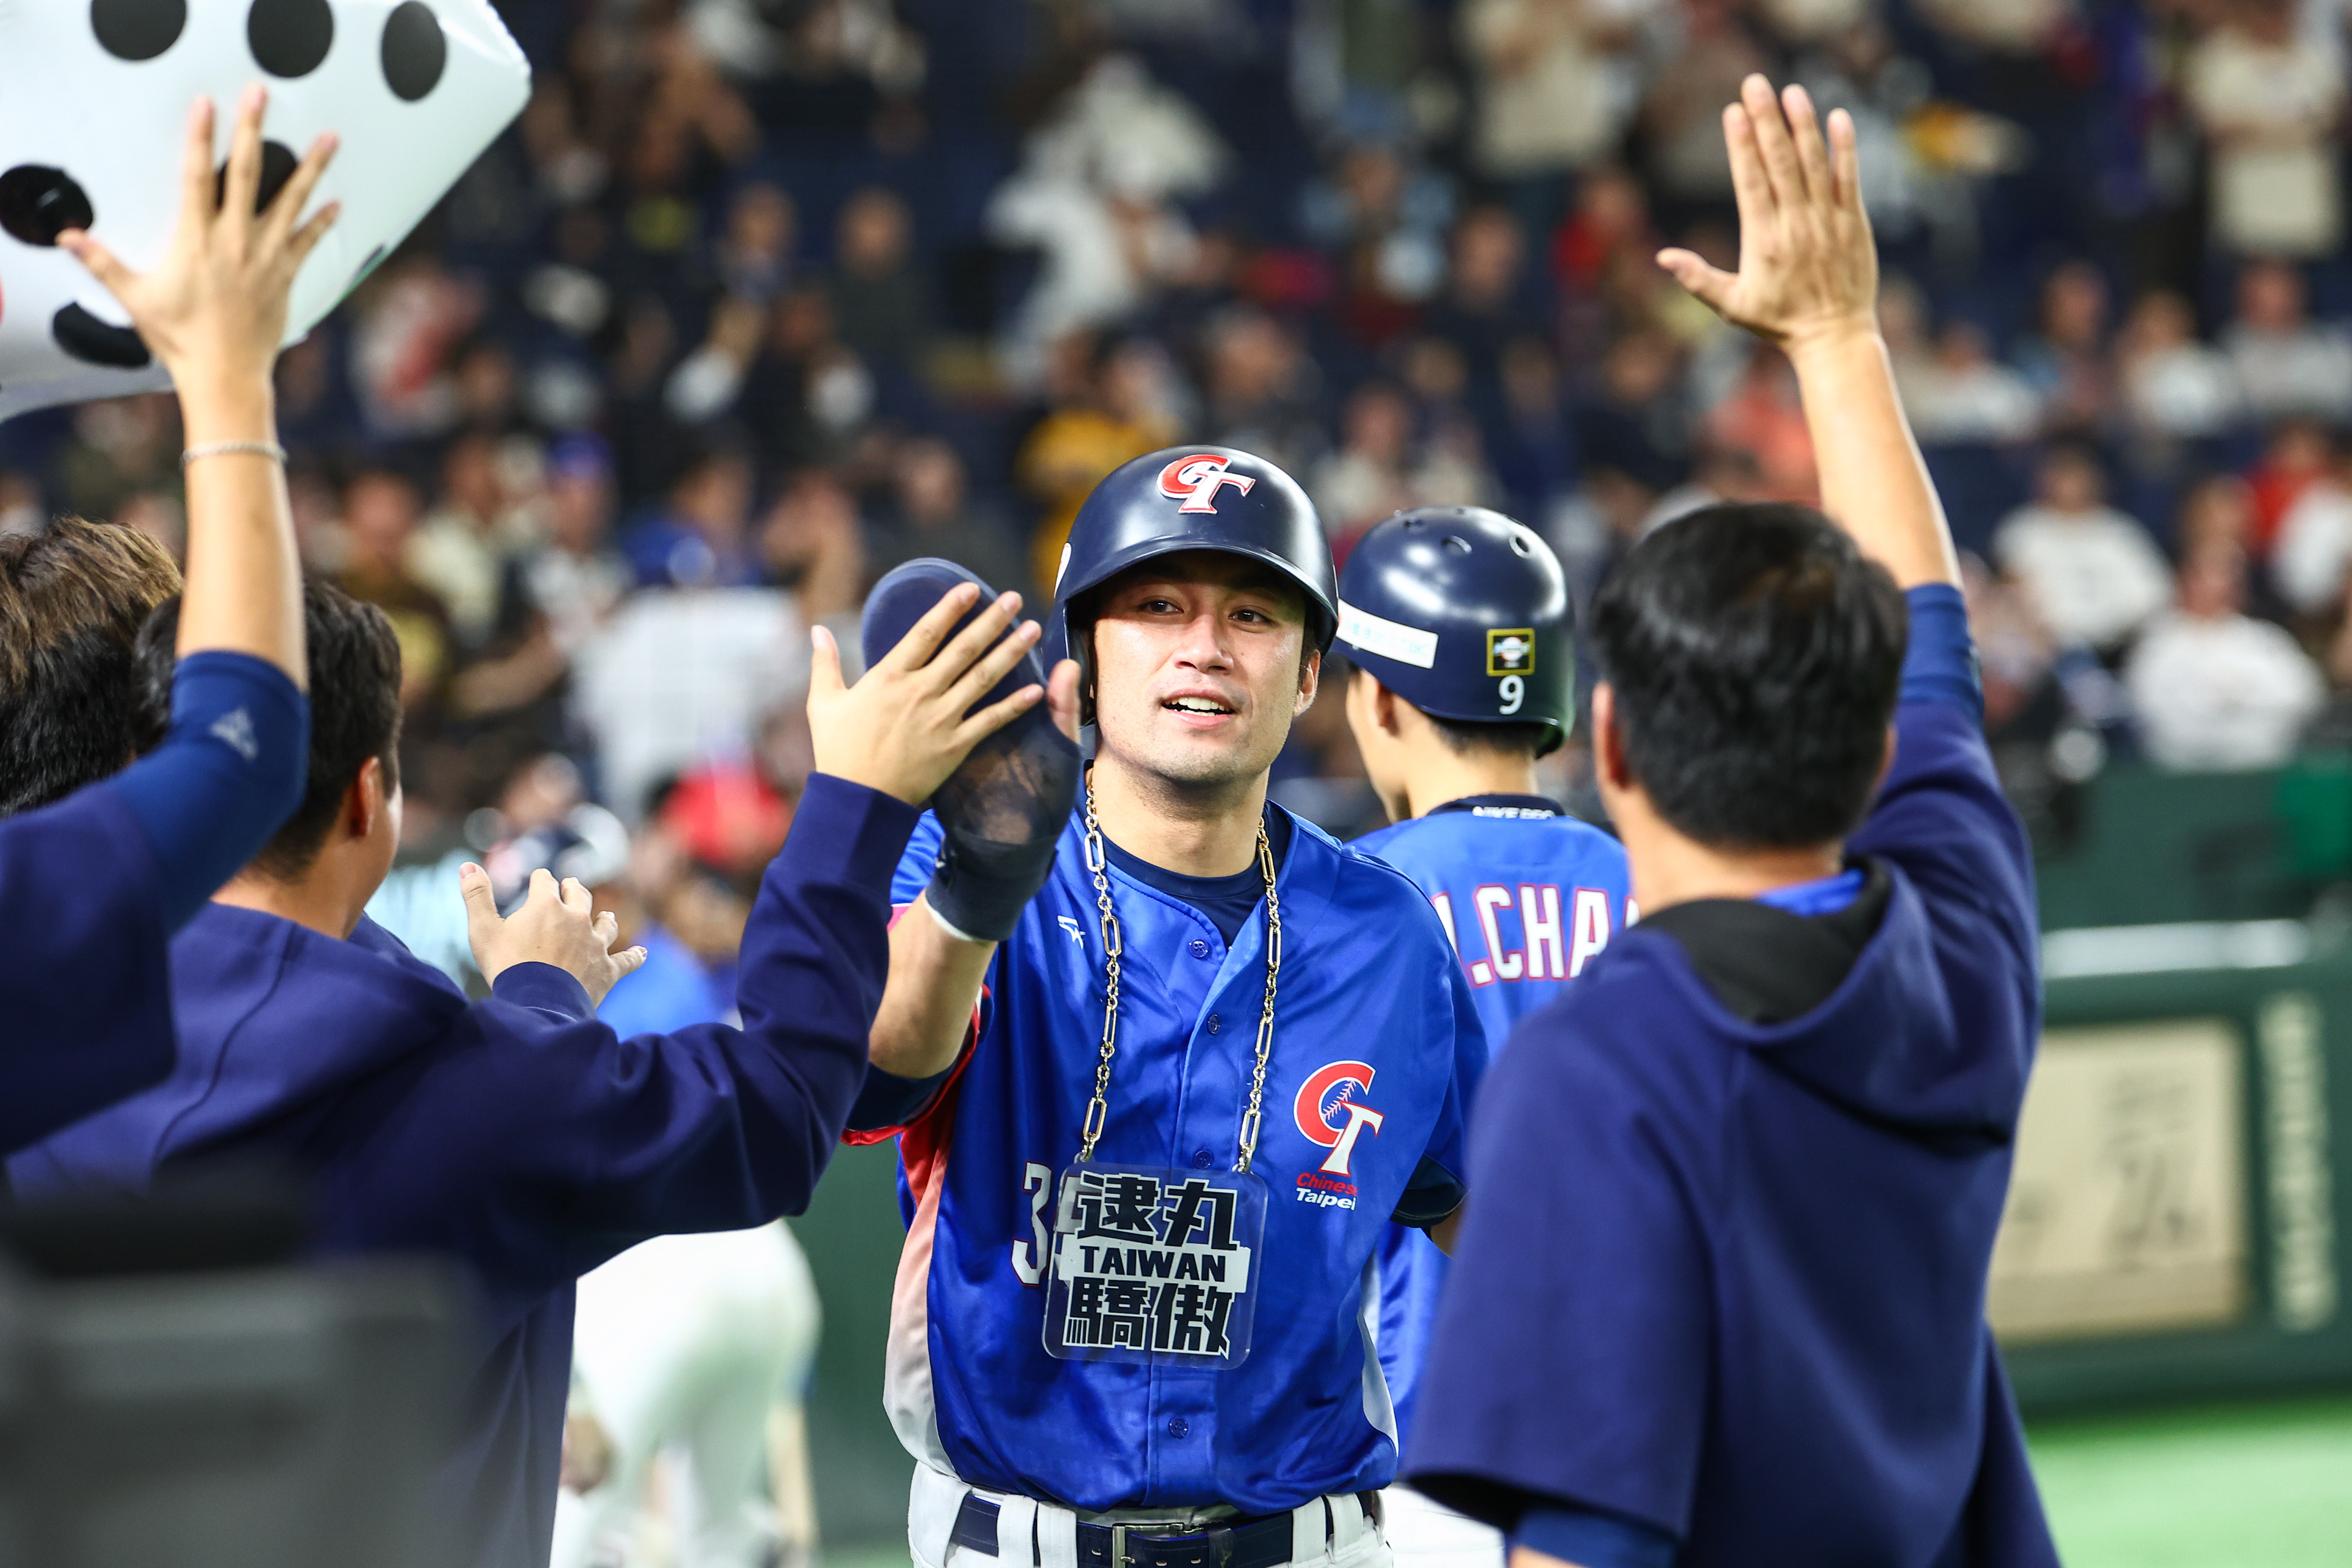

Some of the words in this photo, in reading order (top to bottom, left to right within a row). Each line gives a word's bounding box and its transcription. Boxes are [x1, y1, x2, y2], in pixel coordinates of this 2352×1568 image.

[1499, 675, 1525, 715] 9
[1432, 883, 1641, 988] .CHA
[1296, 1172, 1357, 1197] Chines
[1296, 1187, 1356, 1211] Taipei
[1077, 1171, 1240, 1251] 逮丸
[1079, 1245, 1225, 1282] TAIWAN
[1063, 1276, 1235, 1360] 驕傲
